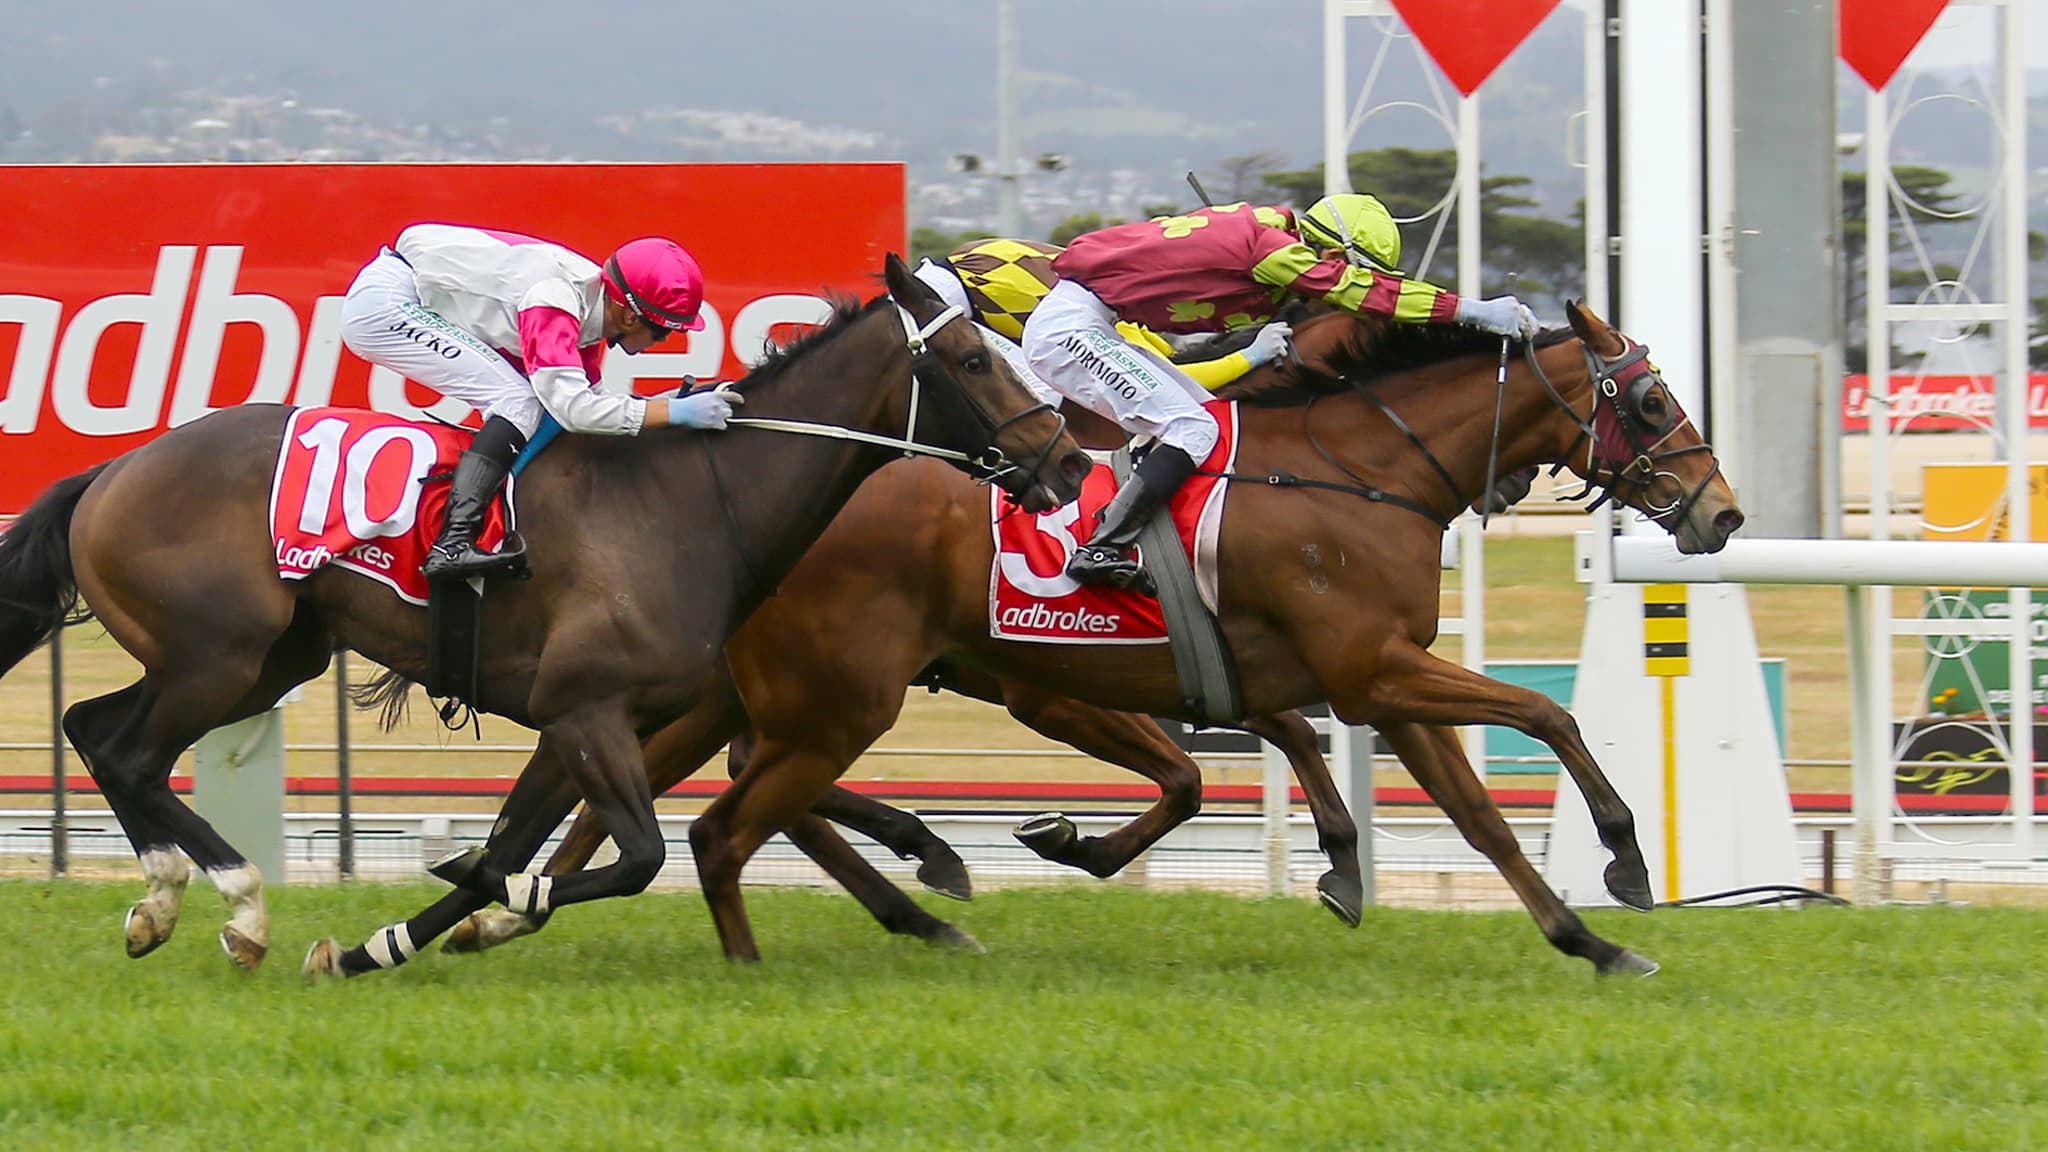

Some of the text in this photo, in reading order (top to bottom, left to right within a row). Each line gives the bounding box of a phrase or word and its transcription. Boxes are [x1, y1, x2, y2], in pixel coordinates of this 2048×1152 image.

[389, 320, 462, 360] JACKO
[1057, 336, 1137, 400] MORIMOTO
[297, 417, 438, 540] 10
[275, 538, 395, 571] Ladbkes
[994, 600, 1120, 633] Ladbrokes
